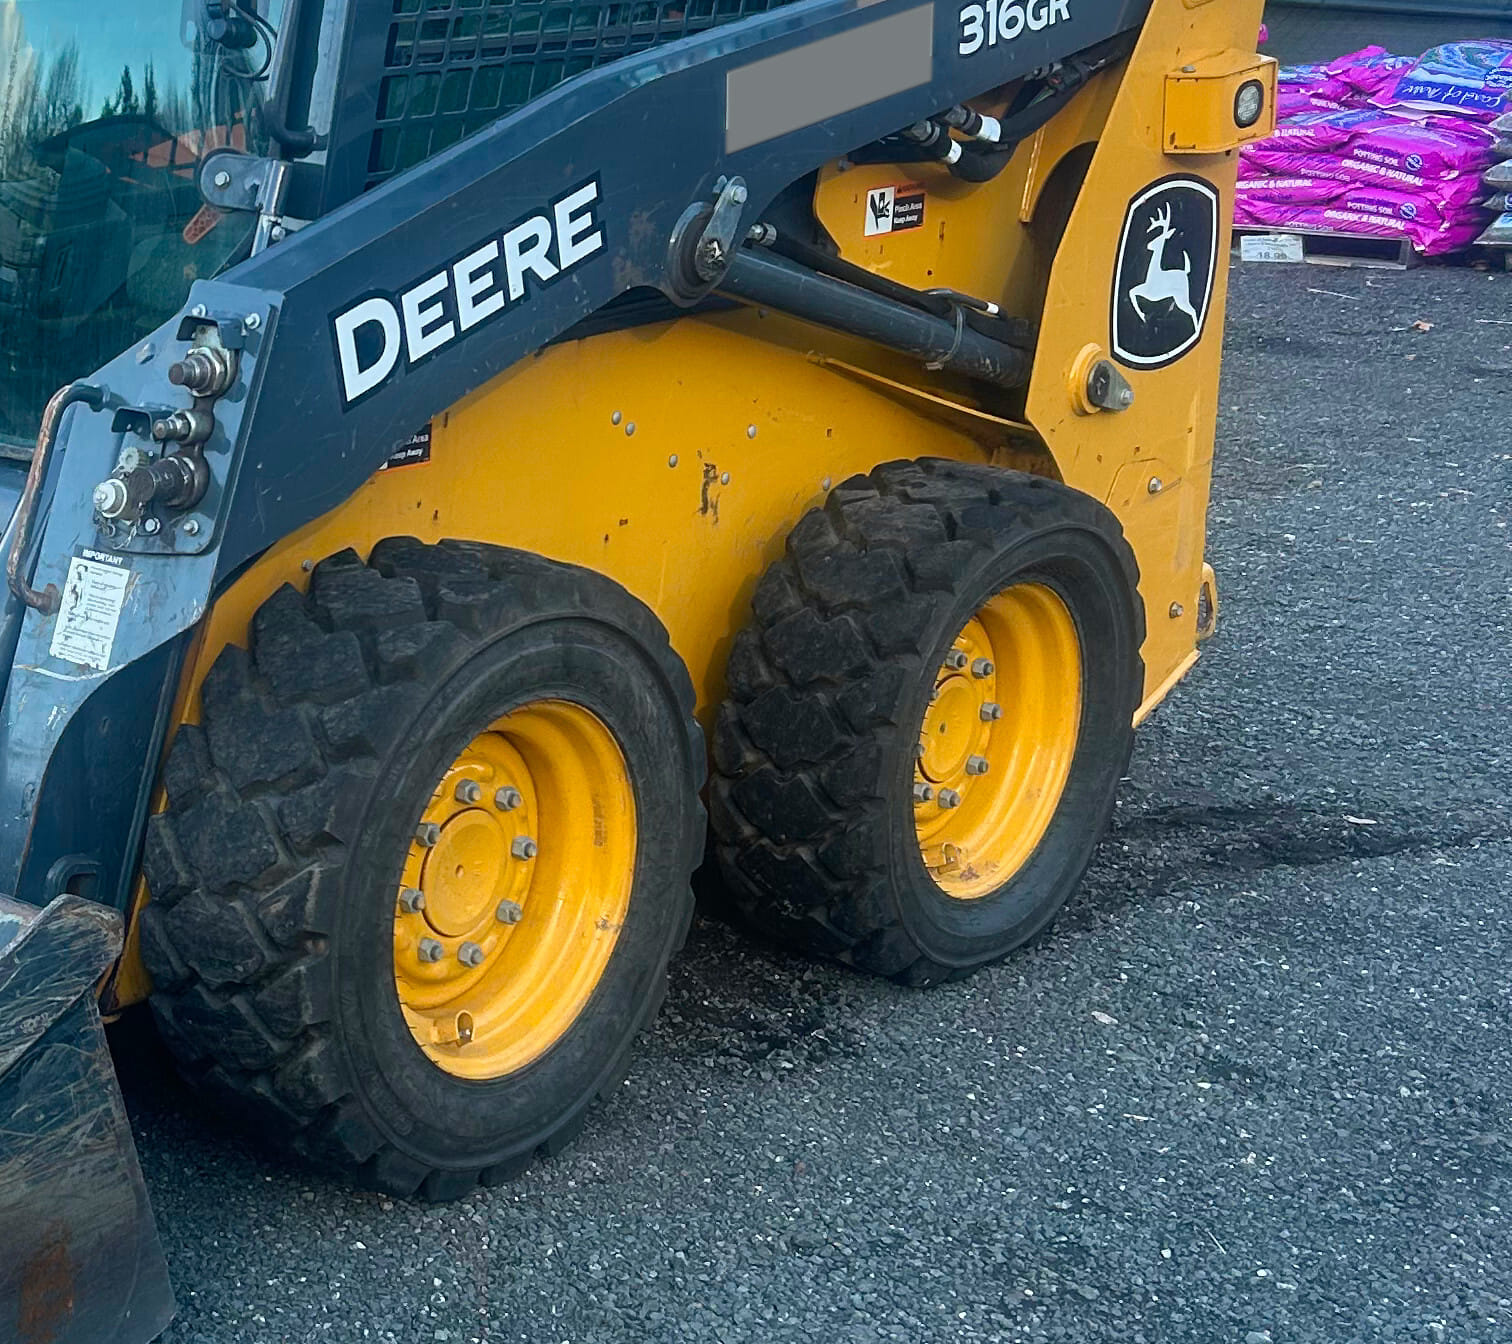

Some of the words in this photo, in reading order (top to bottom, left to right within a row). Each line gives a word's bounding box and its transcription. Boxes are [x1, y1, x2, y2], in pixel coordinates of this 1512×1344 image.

[1353, 148, 1384, 163] POTTING
[1384, 156, 1399, 166] SOIL
[1341, 159, 1380, 173] ORGANIC
[1379, 166, 1386, 175] &
[1386, 168, 1424, 186] NATURAL
[1276, 179, 1312, 188] NATURAL
[1347, 202, 1377, 213] POTTING
[1378, 206, 1393, 215] SOIL
[1324, 209, 1360, 222] ORGANIC
[1368, 216, 1406, 231] NATURAL
[334, 180, 603, 403] DEERE
[82, 548, 124, 565] IMPORTANT
